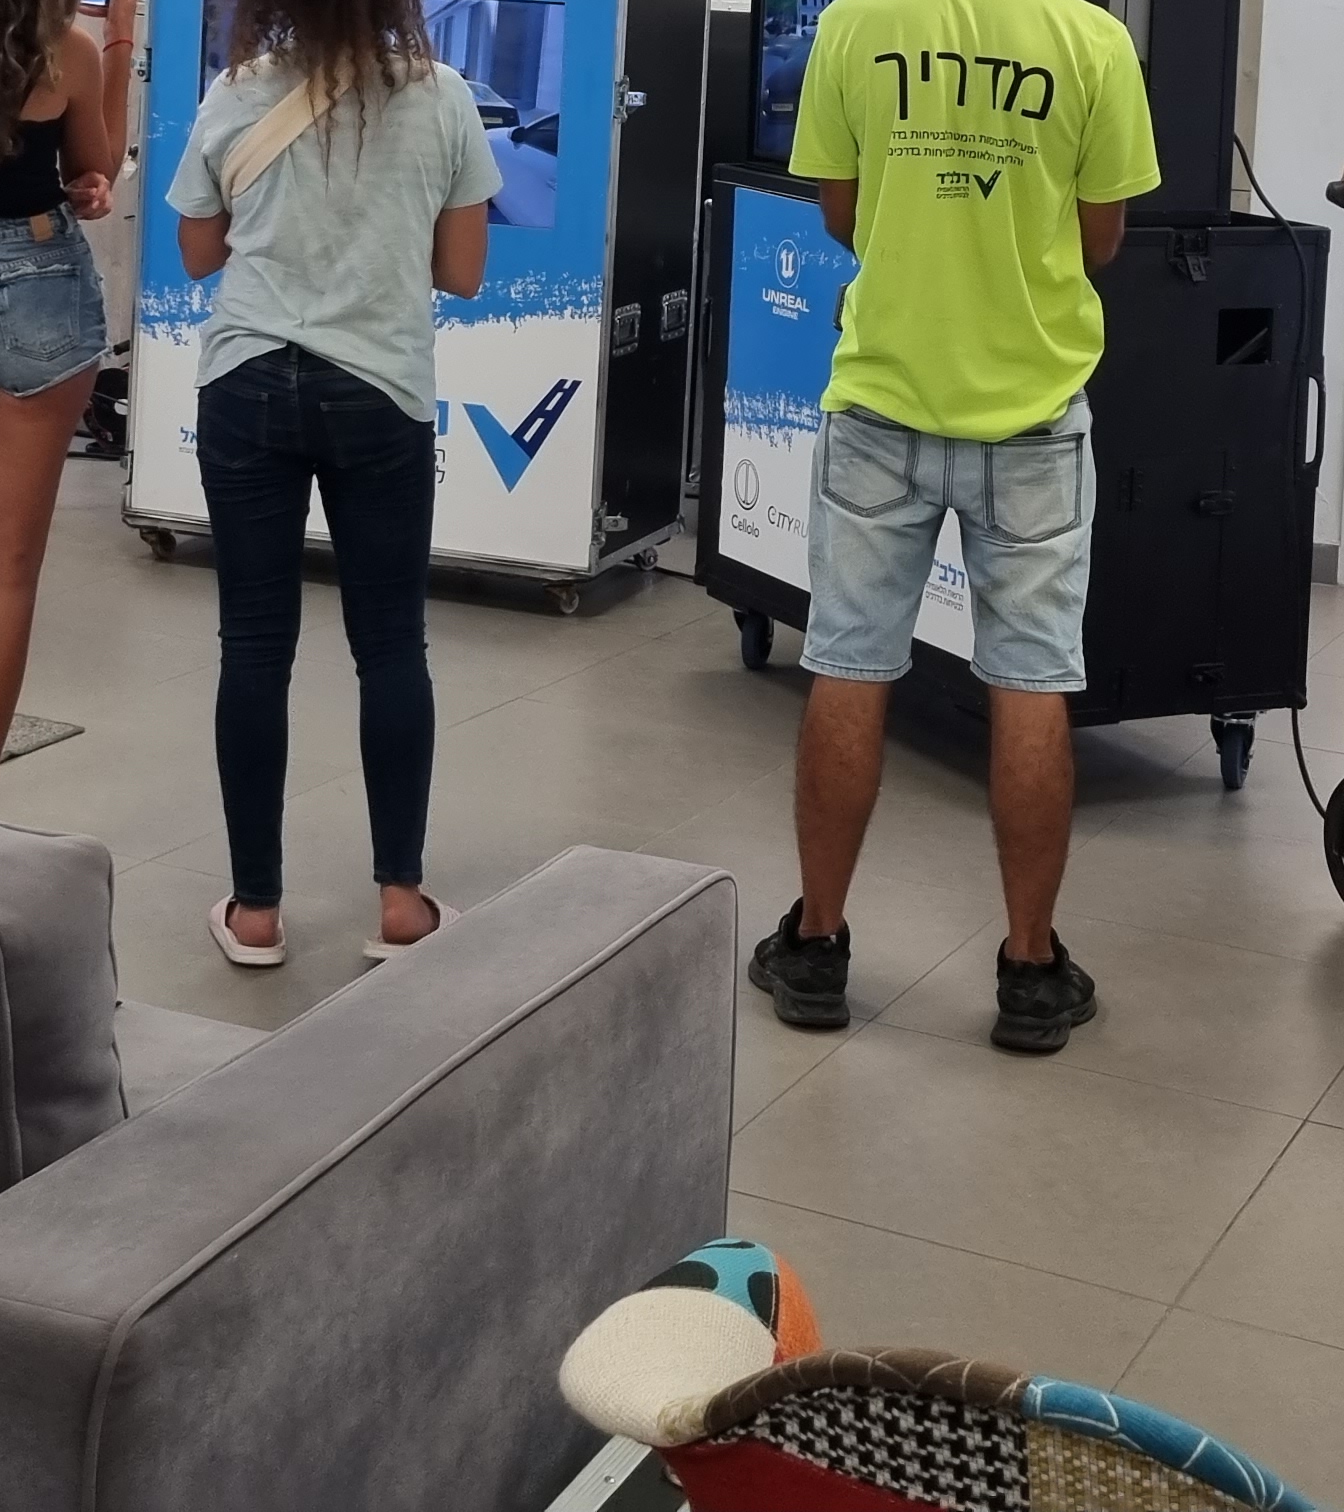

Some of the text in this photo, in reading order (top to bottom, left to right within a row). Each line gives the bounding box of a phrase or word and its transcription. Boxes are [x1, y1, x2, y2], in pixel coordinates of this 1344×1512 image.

[874, 50, 1055, 121] מדריך
[762, 287, 810, 313] UNREAL
[772, 305, 799, 321] ENGINE
[767, 505, 809, 539] CITYRU
[933, 558, 965, 589] רלב"
